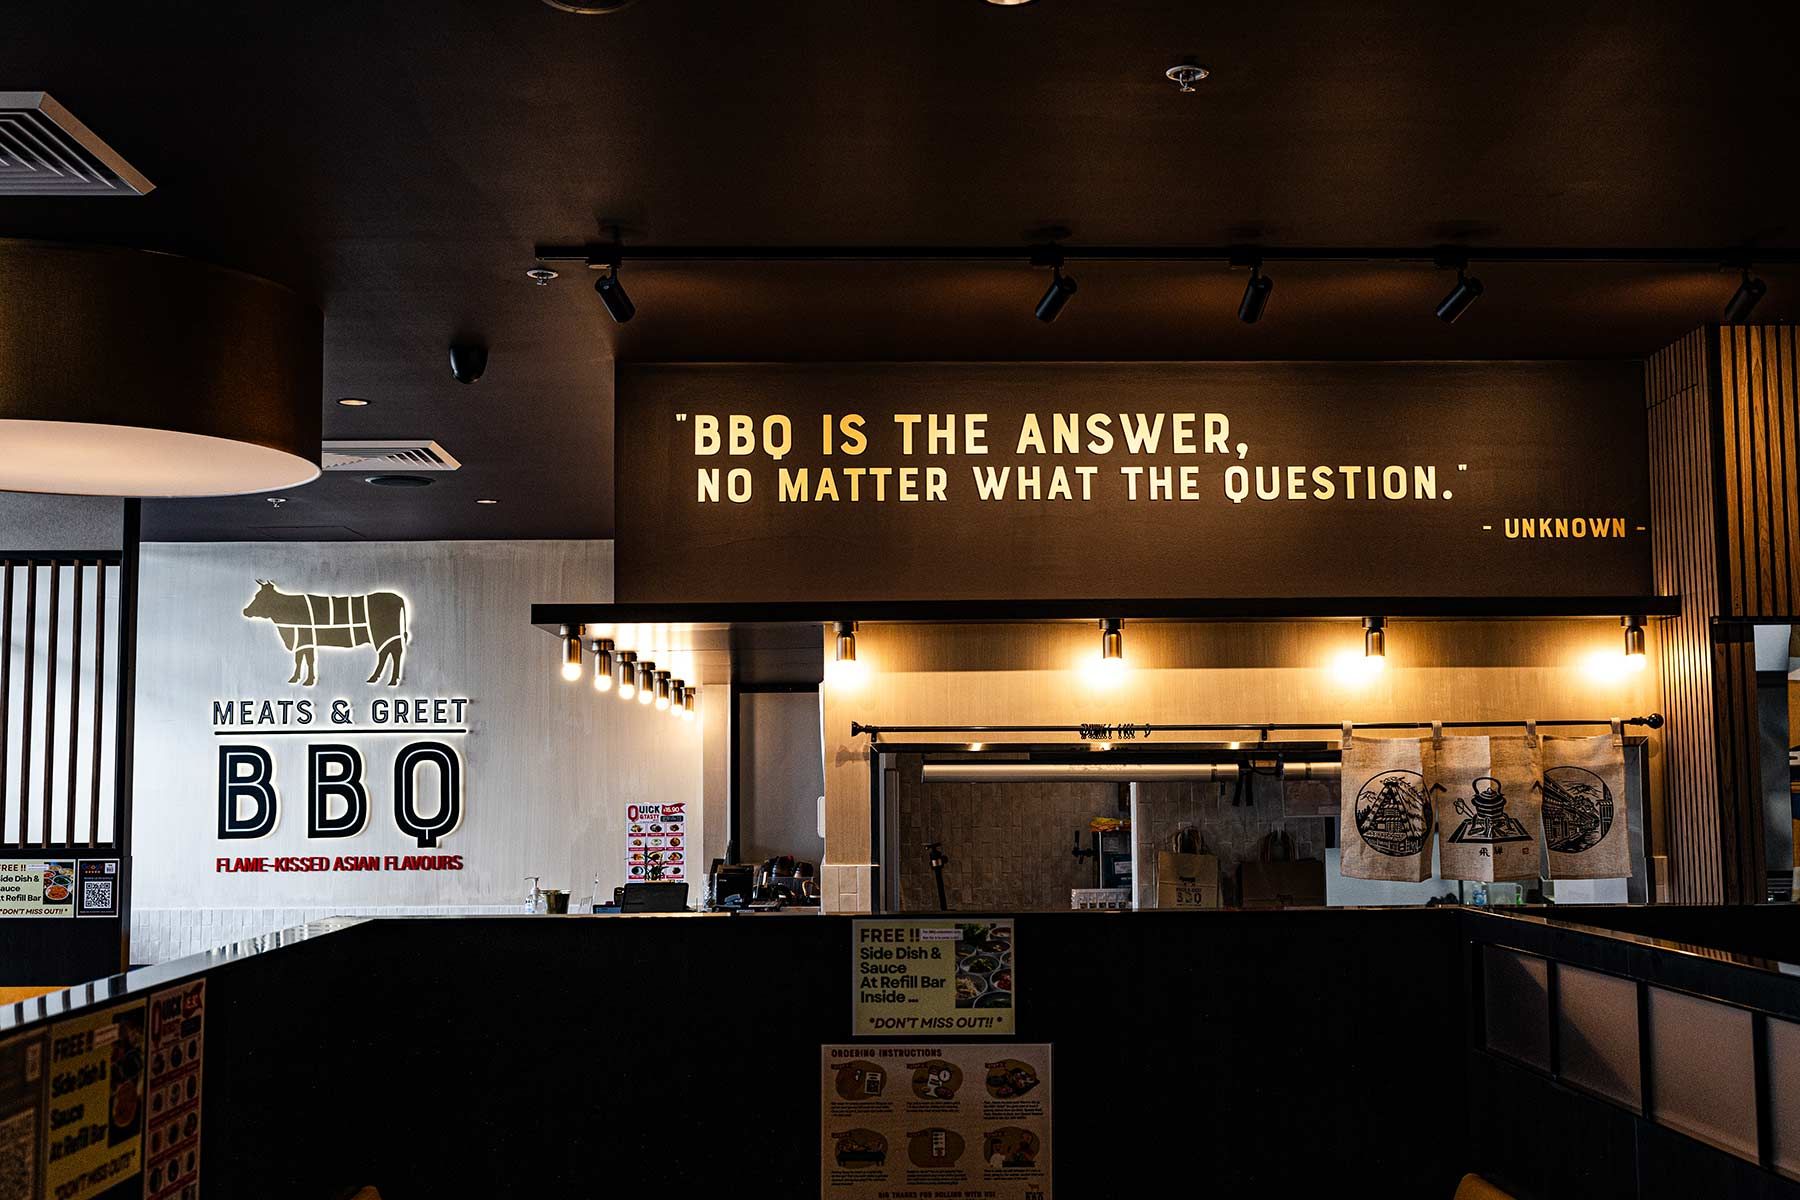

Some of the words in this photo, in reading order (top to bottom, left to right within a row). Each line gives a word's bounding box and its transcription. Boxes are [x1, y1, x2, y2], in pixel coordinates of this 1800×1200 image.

[675, 413, 792, 460] "BBQ
[822, 413, 868, 456] IS
[894, 413, 989, 455] THE
[1016, 412, 1249, 460] ANSWER,
[697, 467, 752, 503] NO
[778, 467, 948, 502] MATTER
[972, 466, 1099, 501] WHAT
[1120, 466, 1200, 501] THE
[1504, 517, 1626, 538] UNKNOWN
[213, 700, 313, 725] MEATS
[330, 700, 353, 724] &
[371, 698, 468, 724] GREET
[217, 741, 460, 849] BBQ
[0, 864, 19, 872] REE
[216, 857, 330, 872] FLAME-KISSED
[332, 856, 382, 871] ASIAN
[384, 855, 464, 870] FLAVOURS
[15, 874, 33, 882] Dish
[27, 894, 42, 902] Bar
[860, 928, 905, 943] FREE
[860, 947, 893, 960] Side
[896, 947, 929, 960] Dish
[931, 947, 942, 960] &
[860, 962, 907, 974] Sauce
[860, 976, 877, 988] At
[880, 975, 917, 988] Refill
[921, 976, 946, 988] Bar
[860, 991, 905, 1003] Inside
[920, 1017, 954, 1029] MISS
[831, 1048, 876, 1058] ORDERING
[879, 1048, 943, 1058] INSTRUCTIONS
